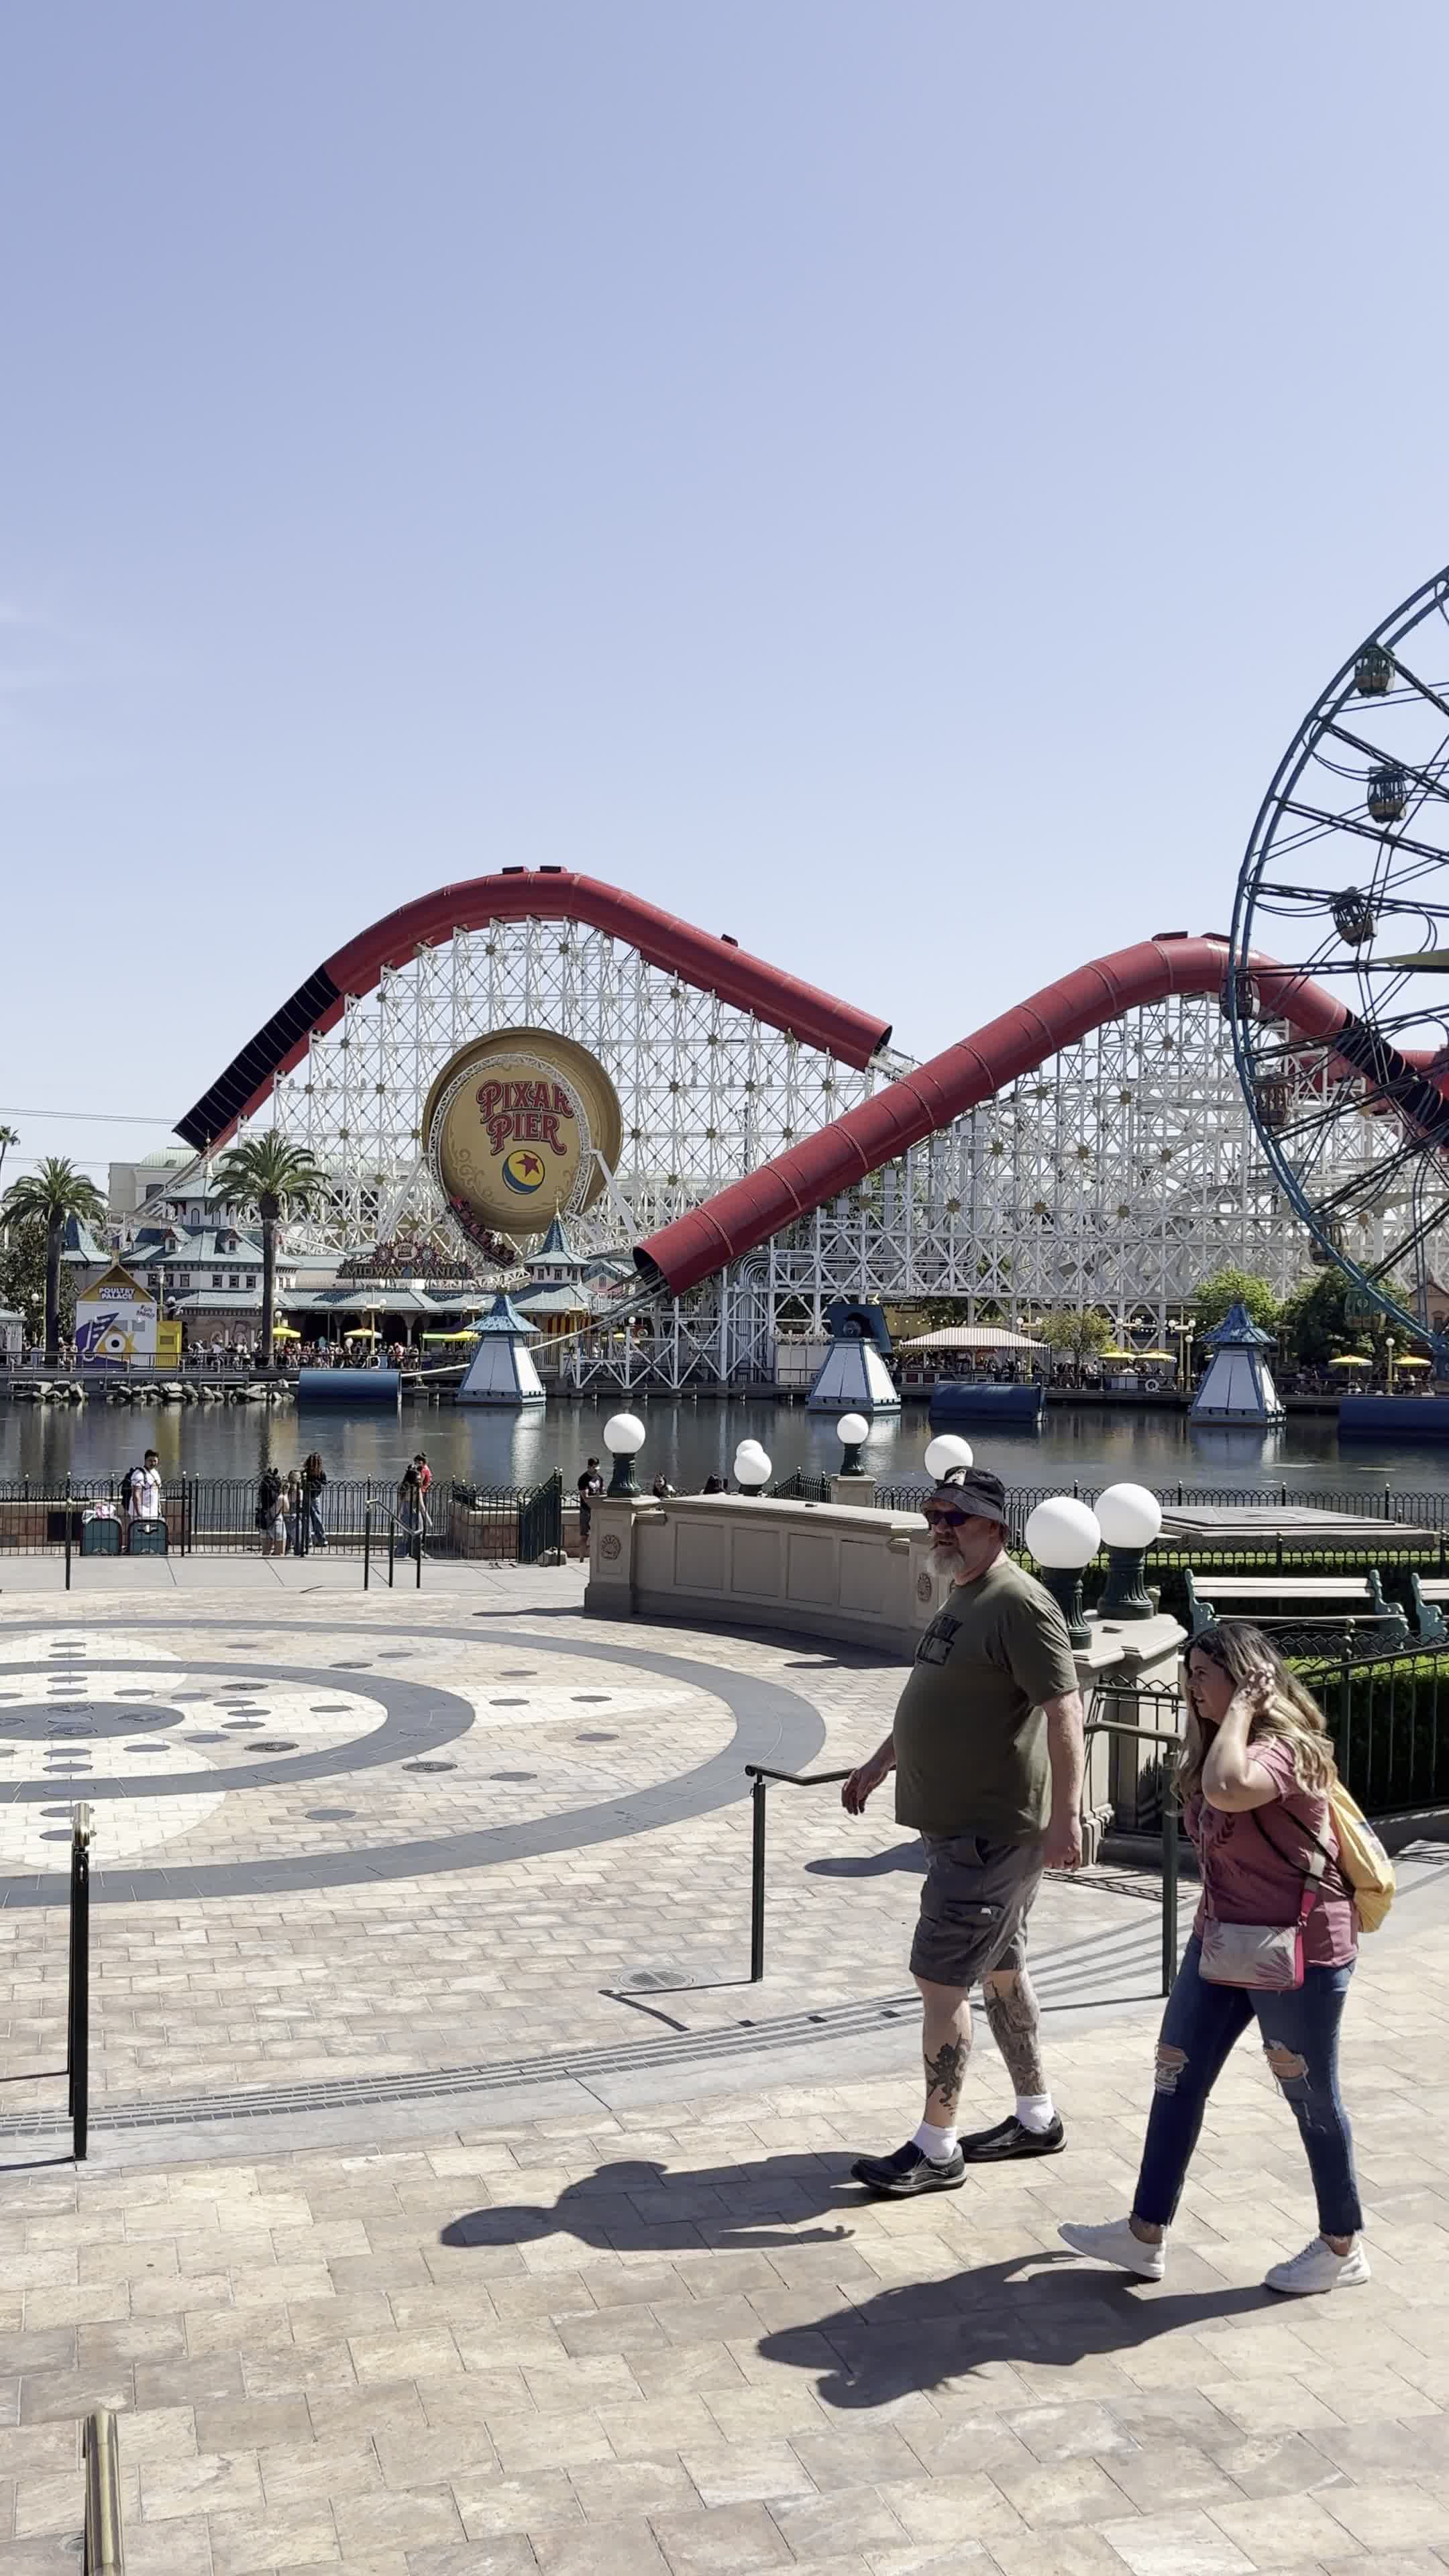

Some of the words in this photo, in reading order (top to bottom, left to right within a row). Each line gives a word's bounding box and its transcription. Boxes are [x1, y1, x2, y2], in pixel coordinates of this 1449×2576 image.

[476, 1079, 574, 1124] PIXAR
[488, 1111, 568, 1156] PIER
[345, 1266, 404, 1277] MIDWAY
